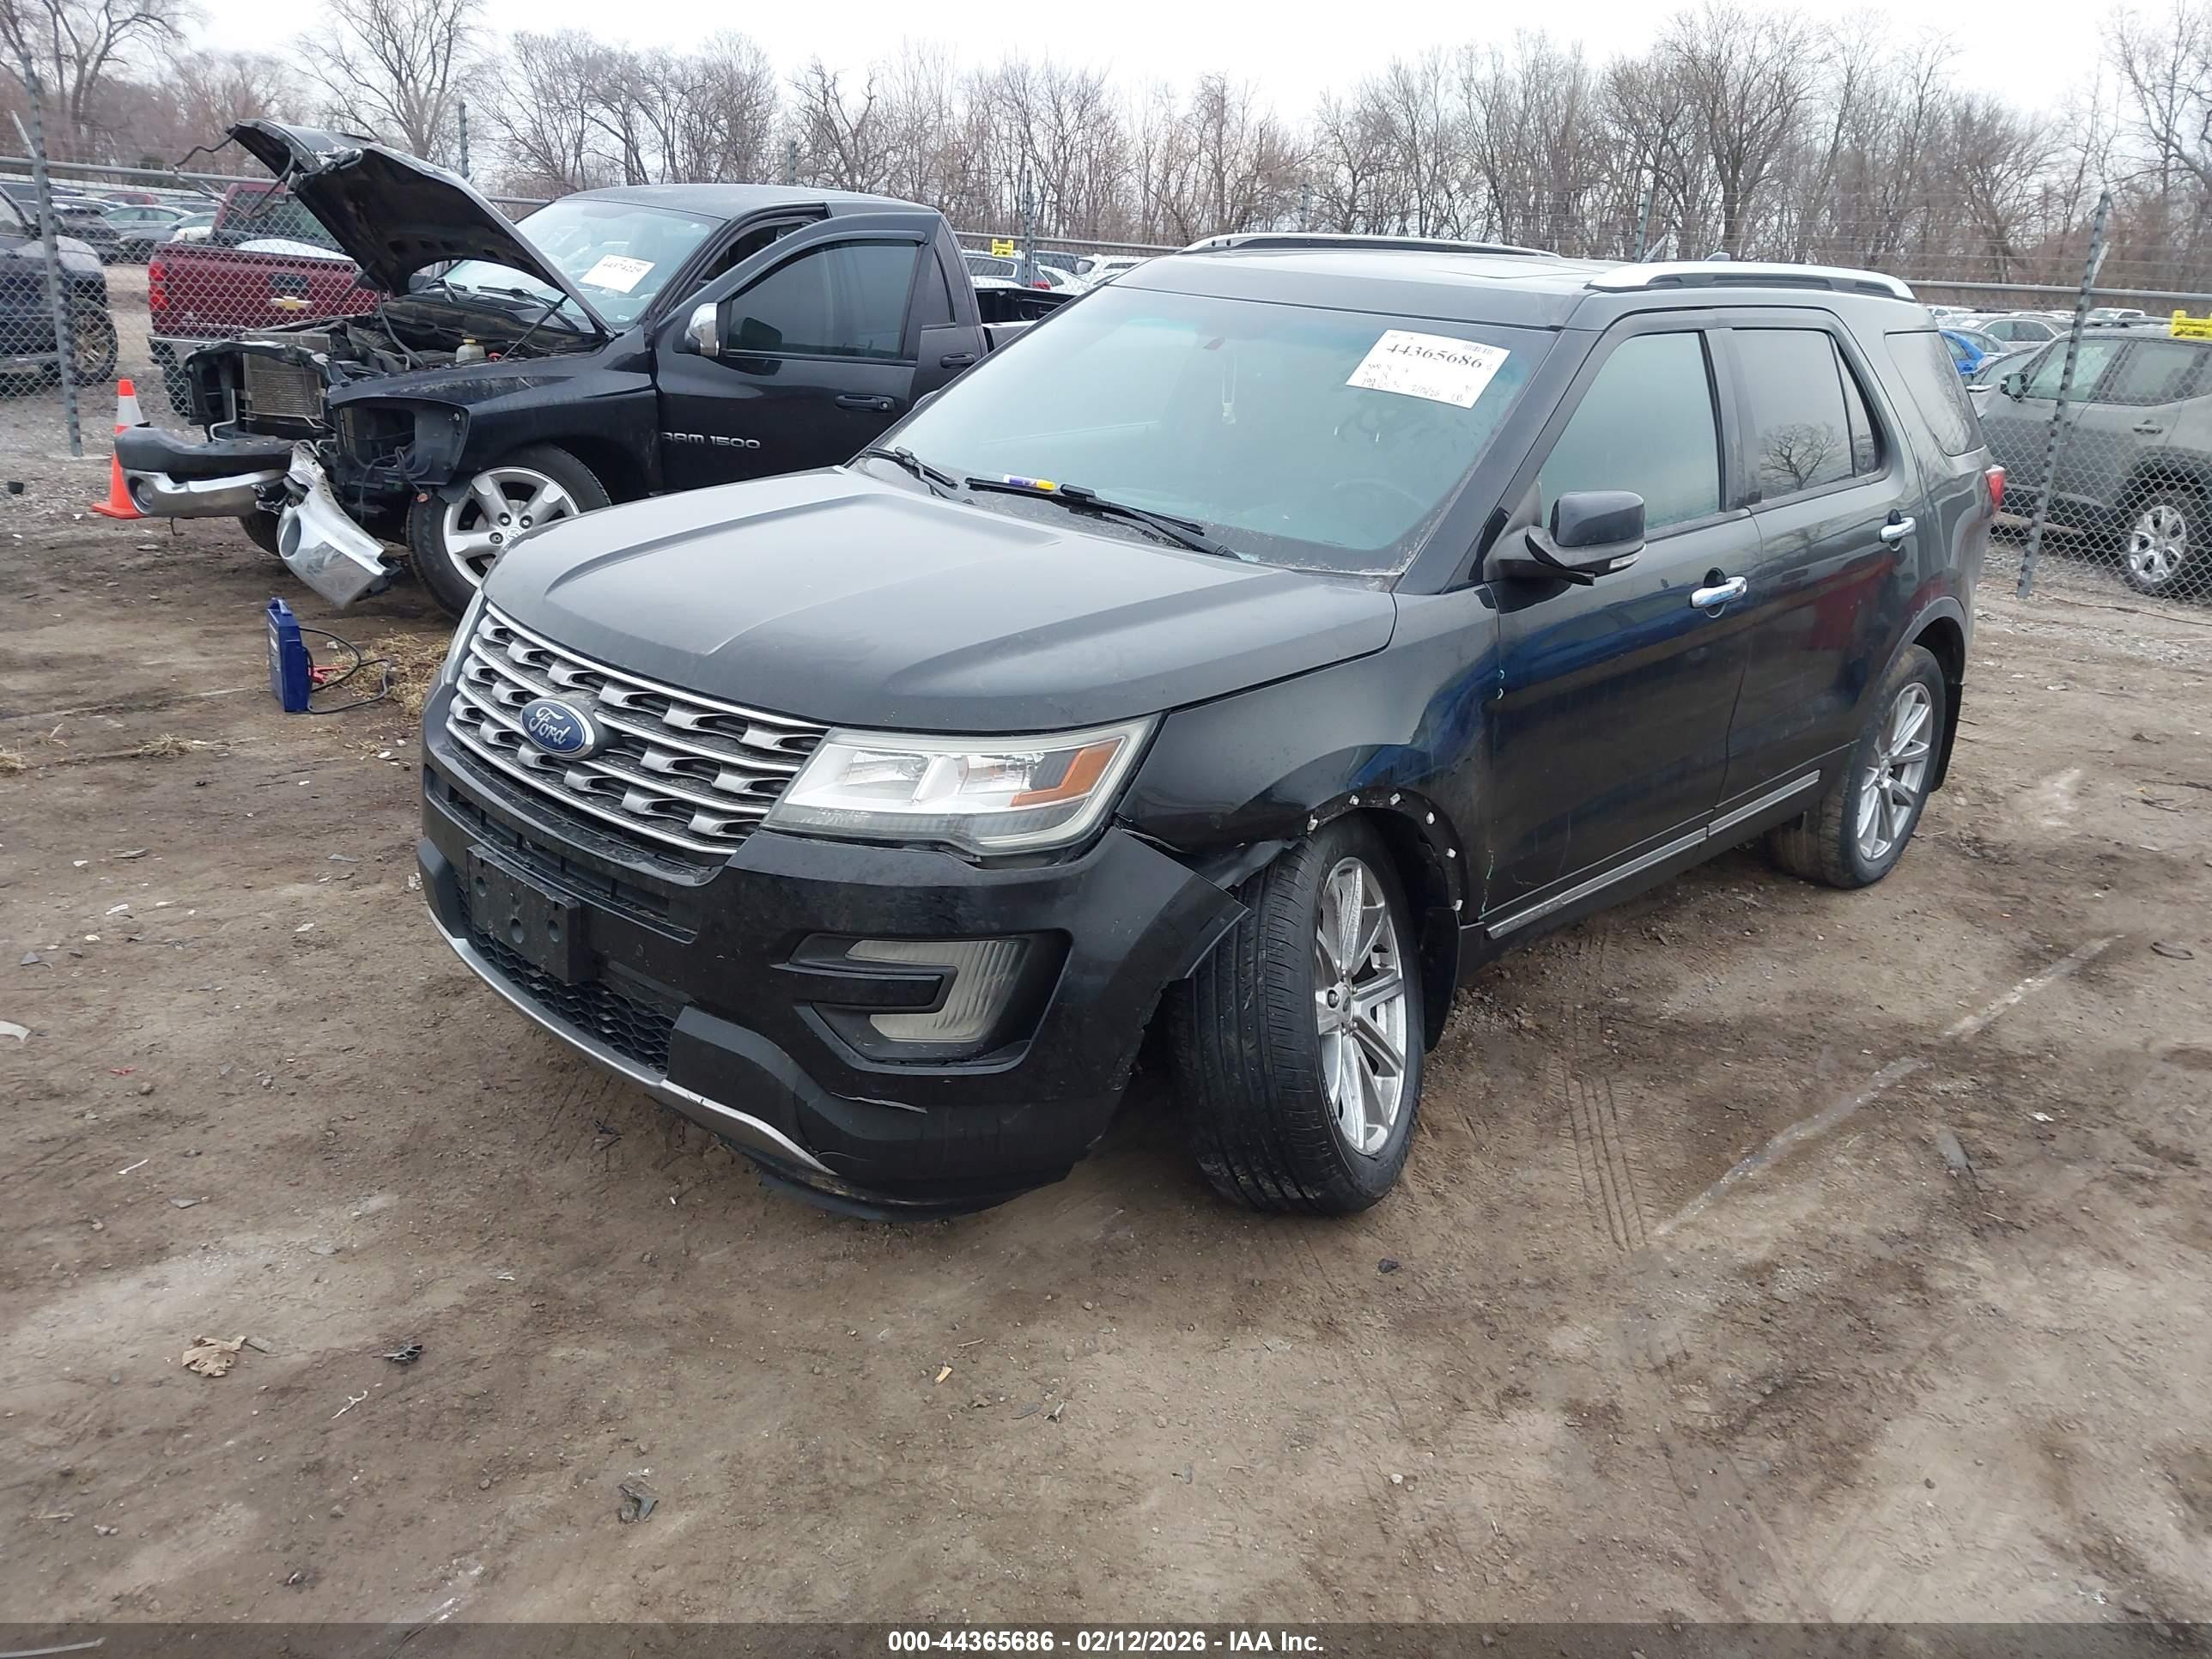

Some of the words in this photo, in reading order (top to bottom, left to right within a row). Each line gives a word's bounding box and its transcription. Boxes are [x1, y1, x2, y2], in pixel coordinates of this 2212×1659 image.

[1386, 343, 1482, 369] 44365686
[659, 431, 704, 445] RAM
[709, 434, 761, 449] 1500
[528, 706, 572, 745] Ford
